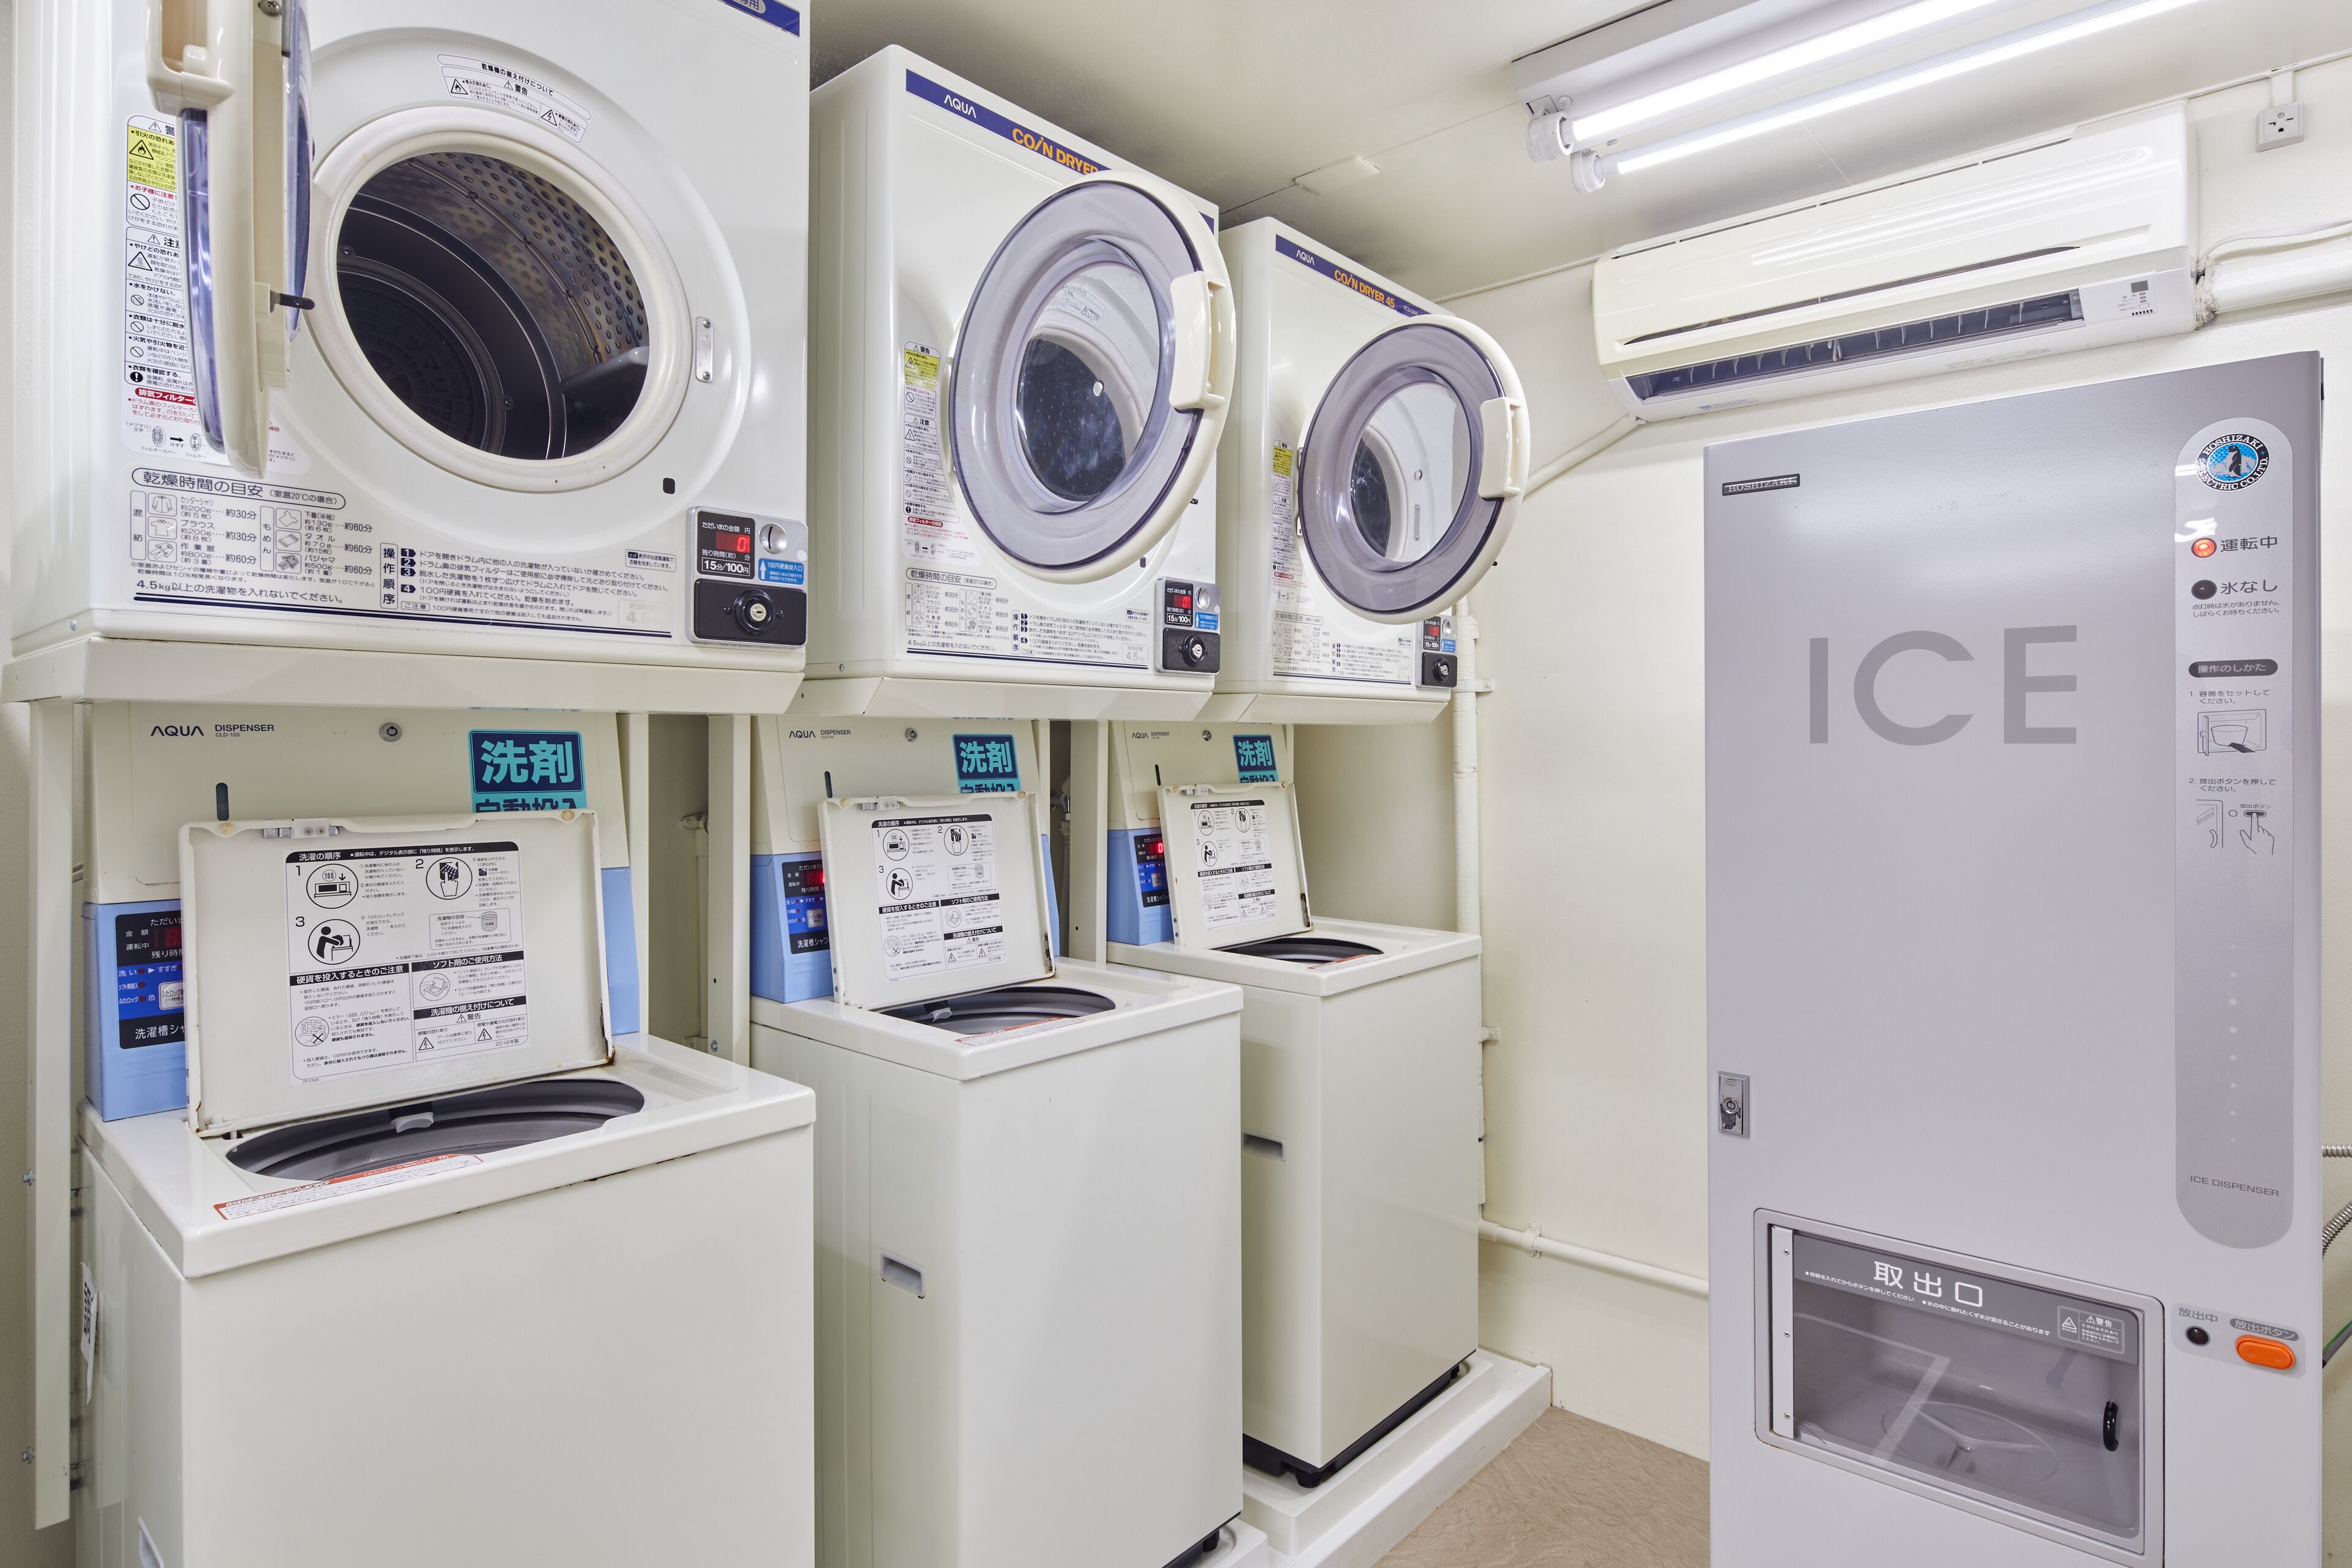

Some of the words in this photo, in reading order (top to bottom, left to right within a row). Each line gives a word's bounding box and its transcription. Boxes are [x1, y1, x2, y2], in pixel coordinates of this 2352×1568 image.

[481, 62, 554, 96] 乾燥機の据え付けについて
[514, 84, 528, 96] 警告
[944, 94, 977, 119] AQUA
[1012, 127, 1053, 159] COIN
[1296, 249, 1315, 266] AQUA
[1334, 269, 1358, 290] COIN
[1359, 282, 1384, 303] DRYER
[1385, 295, 1395, 309] 45
[133, 282, 176, 296] 水をかけない。
[920, 345, 930, 354] 警告
[133, 365, 181, 378] 衣類を確認する。
[919, 418, 930, 426] 注意
[2203, 434, 2264, 456] HOSHIZAKI
[143, 471, 263, 498] 乾燥時間の目安
[1727, 478, 1797, 493] HOSHIZAKI
[225, 508, 257, 521] 約30分
[181, 519, 216, 530] ブラウス
[344, 522, 372, 533] 約60分
[701, 521, 741, 533] ただいまの金額
[225, 531, 257, 543] 約30分
[344, 543, 372, 555] 約60分
[736, 537, 748, 552] 0
[2220, 535, 2278, 552] 運転中
[225, 553, 257, 565] 約60分
[304, 554, 336, 565] パジャマ
[701, 548, 737, 560] 残り時間(約)
[344, 565, 372, 576] 約60分
[704, 560, 750, 575] 15分/100円
[767, 562, 803, 572] 100円硬貨投入口
[383, 548, 395, 605] 操作順序
[911, 570, 961, 584] 乾燥時間の目安
[2220, 579, 2278, 595] 氷なし
[404, 601, 428, 611] ご注意
[1182, 597, 1188, 608] 0
[2192, 600, 2280, 610] 点灯時は氷がありません。
[2193, 607, 2280, 617] しばらくお待ちください。
[2197, 662, 2266, 674] 操作のしかた
[1809, 625, 2078, 746] ICE
[151, 725, 205, 737] AQUA
[789, 730, 815, 739] AQUA
[960, 741, 1012, 774] 洗剤
[1238, 740, 1273, 767] 洗剤
[480, 739, 575, 785] 洗剤
[1158, 843, 1164, 853] 0
[299, 852, 341, 862] 洗濯の順序
[415, 859, 424, 869] 2
[295, 865, 301, 876] 1
[951, 895, 989, 905] ソフト剤のご使用方法
[881, 901, 937, 914] 硬貨を投入するときのご注意
[295, 916, 305, 927] 3
[952, 927, 997, 938] 洗濯機の据え付けについて
[126, 942, 149, 951] 運転中
[432, 954, 503, 969] ソフト剤のご使用方法
[157, 964, 177, 973] すすぎ
[296, 965, 404, 984] 硬貨を投入するときのご注意
[119, 996, 138, 1005] ふたロック
[431, 998, 514, 1017] 洗濯機の据え付けについて
[495, 1038, 519, 1047] 2016年製
[2190, 1175, 2209, 1185] ICE
[2212, 1179, 2280, 1197] DISPENSER
[1809, 1271, 1915, 1302] 容器を入れてからボタンを押してください
[1873, 1261, 1983, 1308] 取出口
[2179, 1307, 2218, 1323] 放出中
[2095, 1316, 2113, 1328] 警告
[2081, 1323, 2119, 1335] ケガのおそれあり
[2234, 1319, 2296, 1340] 放出ボタン
